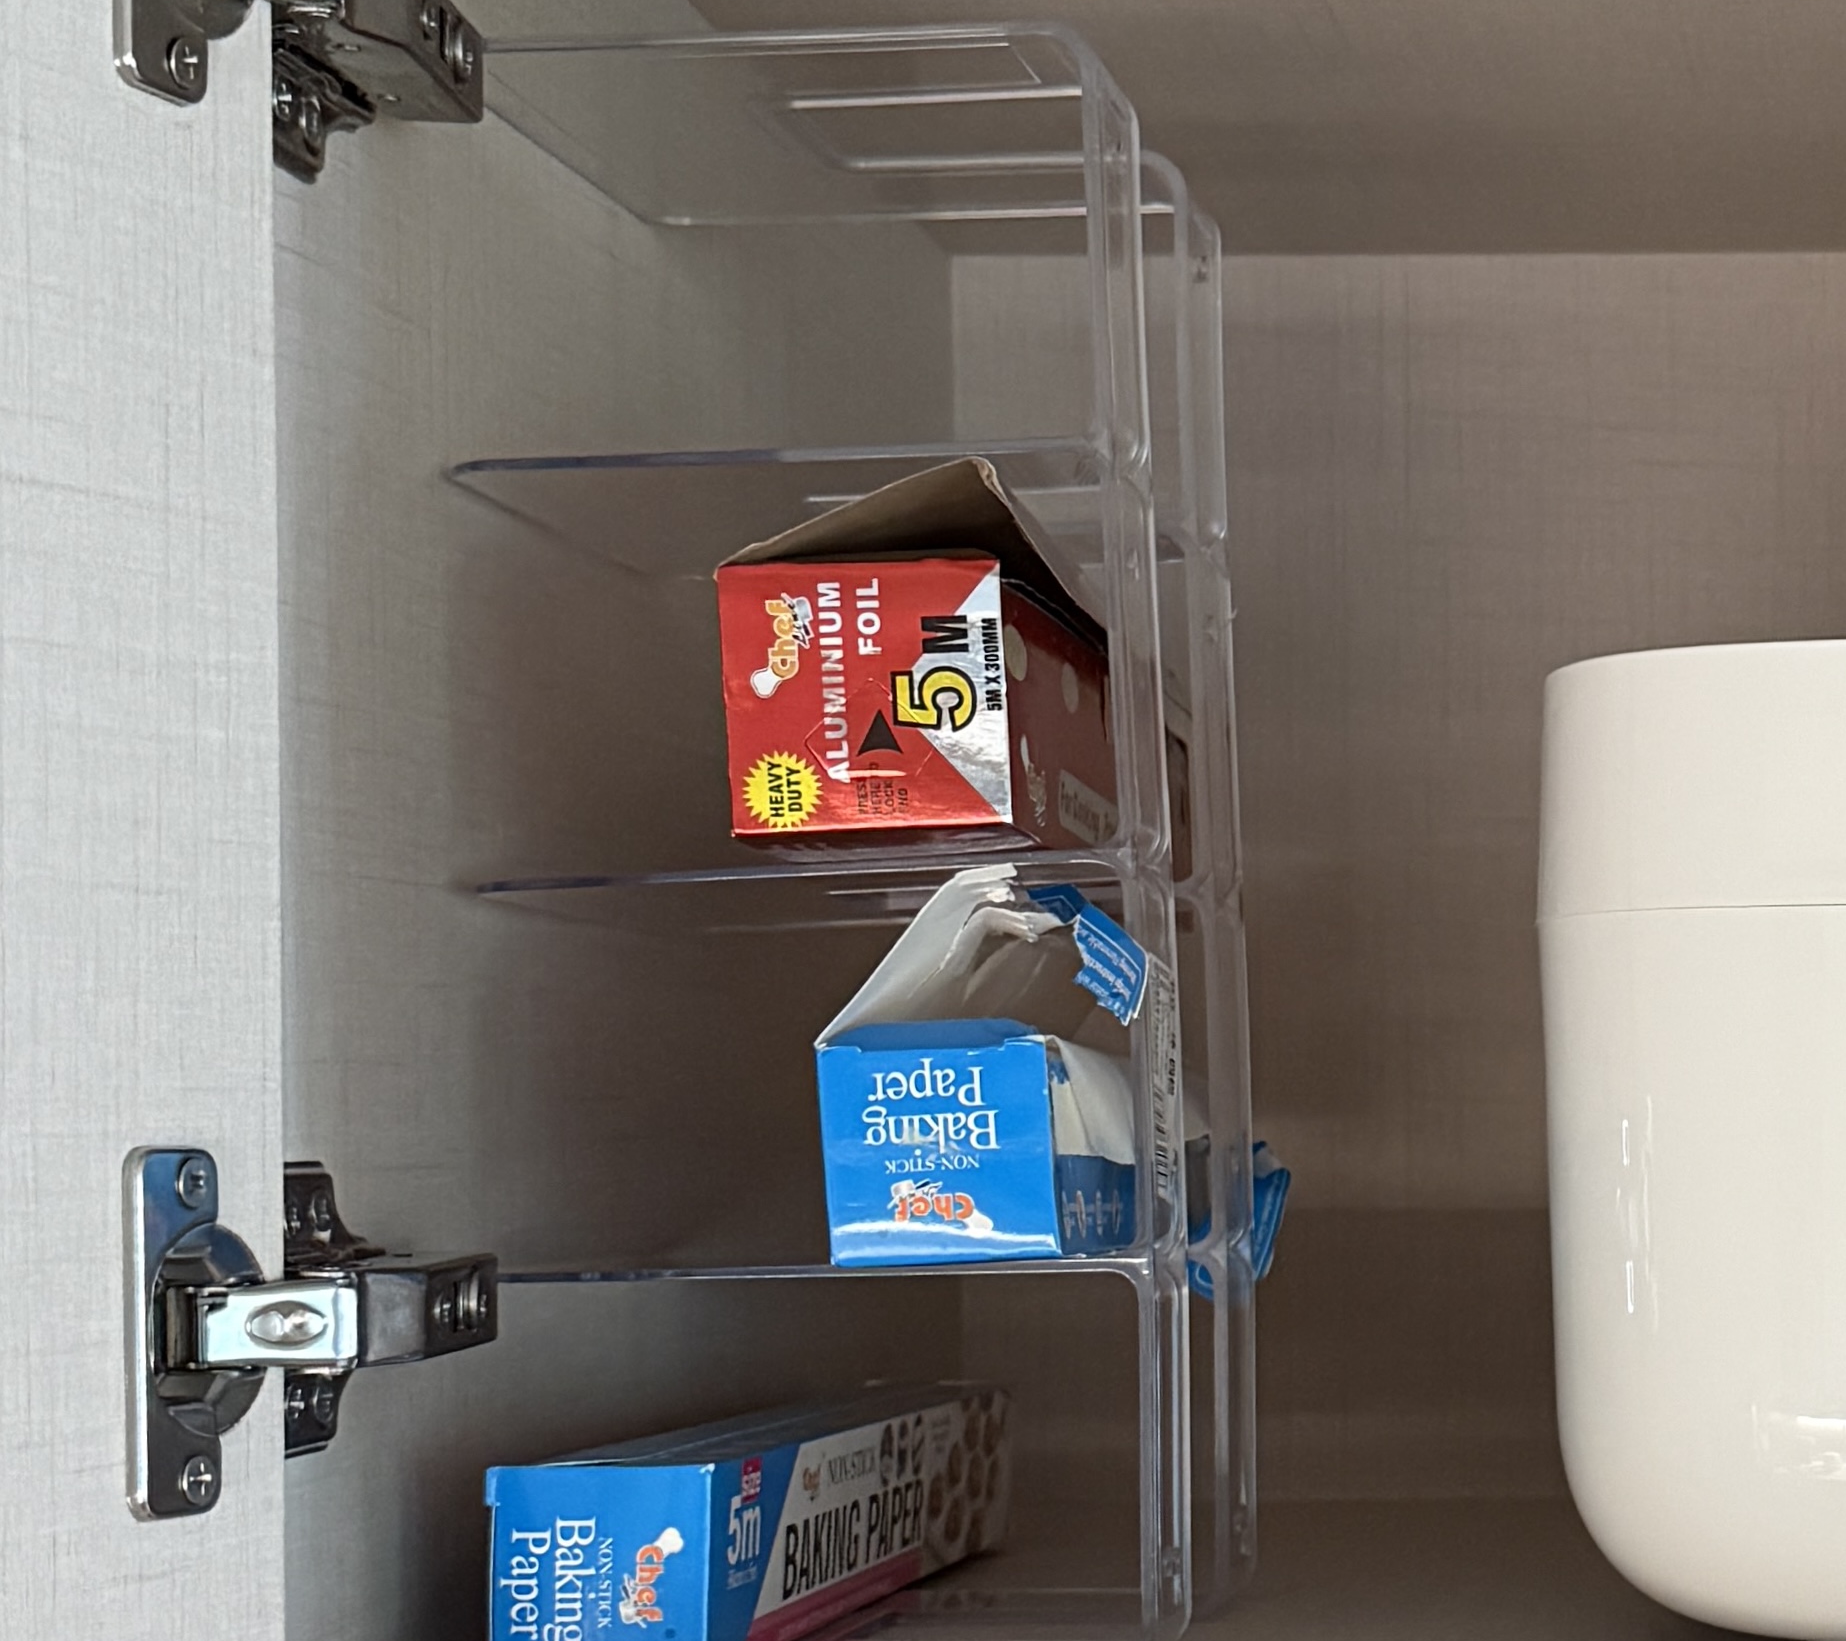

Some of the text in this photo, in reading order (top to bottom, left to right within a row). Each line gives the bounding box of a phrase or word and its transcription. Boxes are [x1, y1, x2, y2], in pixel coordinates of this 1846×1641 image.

[856, 577, 881, 656] FOIL
[981, 616, 1002, 670] 300MM
[816, 581, 851, 783] ALUMINIUM
[766, 761, 784, 818] HEAVY
[788, 765, 803, 813] DUTY
[866, 1058, 987, 1107] Paper
[861, 1105, 1001, 1156] Baking
[884, 1154, 980, 1174] NON-STICK
[894, 1193, 975, 1224] Chef
[727, 1495, 762, 1566] 5m
[782, 1478, 924, 1601] BAKING PAPER
[499, 1528, 552, 1641] Paper
[597, 1536, 613, 1630] NON-STICK
[635, 1544, 665, 1623] Chef
